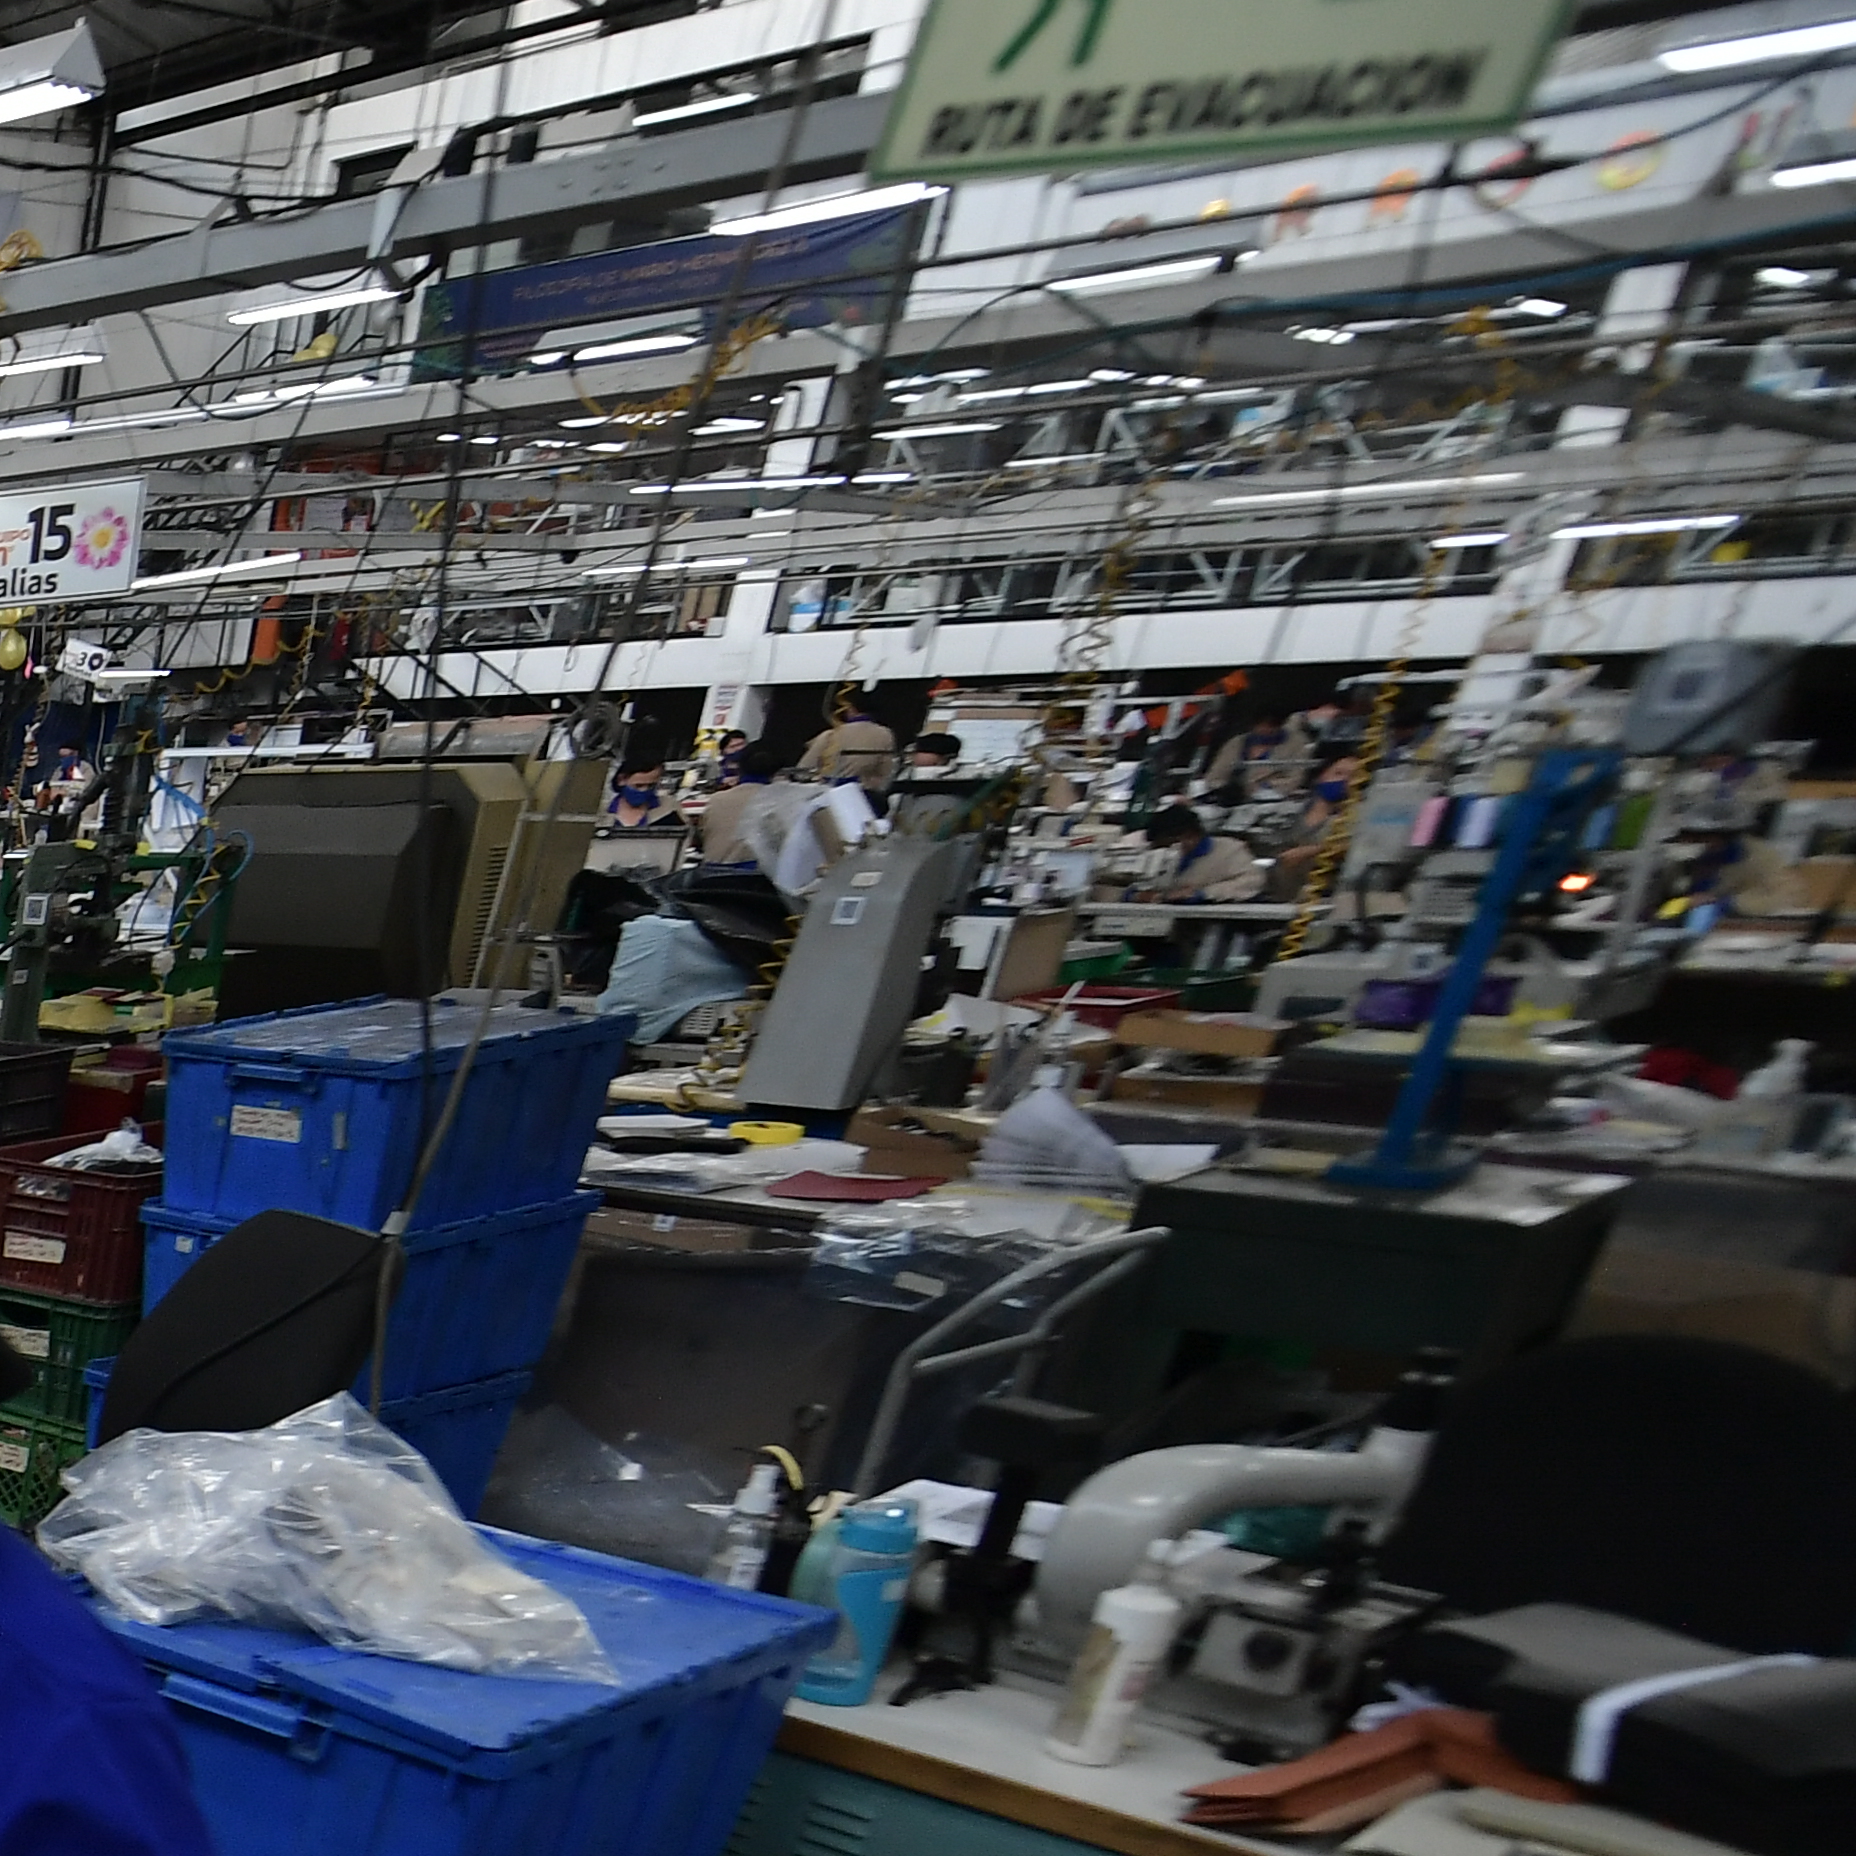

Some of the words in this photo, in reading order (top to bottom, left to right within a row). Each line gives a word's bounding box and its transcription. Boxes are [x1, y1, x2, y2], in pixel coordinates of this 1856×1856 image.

[920, 95, 1041, 159] RUTA
[1048, 85, 1124, 146] DE
[27, 503, 77, 565] 15
